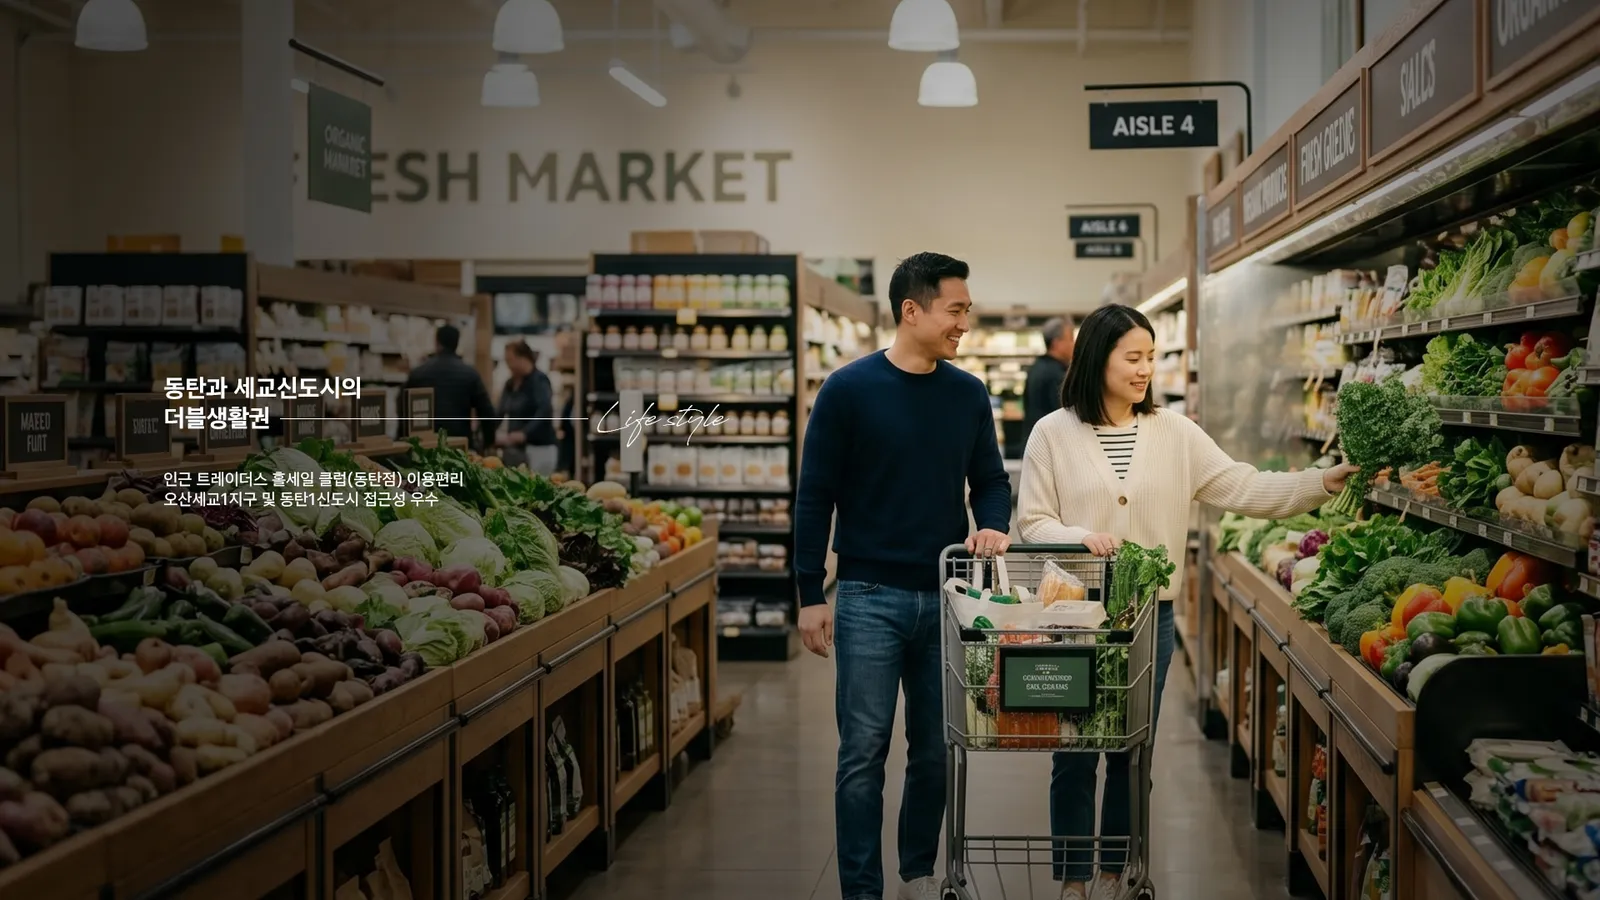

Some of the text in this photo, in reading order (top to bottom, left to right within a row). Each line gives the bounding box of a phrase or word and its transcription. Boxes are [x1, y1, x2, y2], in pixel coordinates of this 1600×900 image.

[1113, 114, 1195, 136] AISLE 4
[507, 151, 793, 203] MARKET
